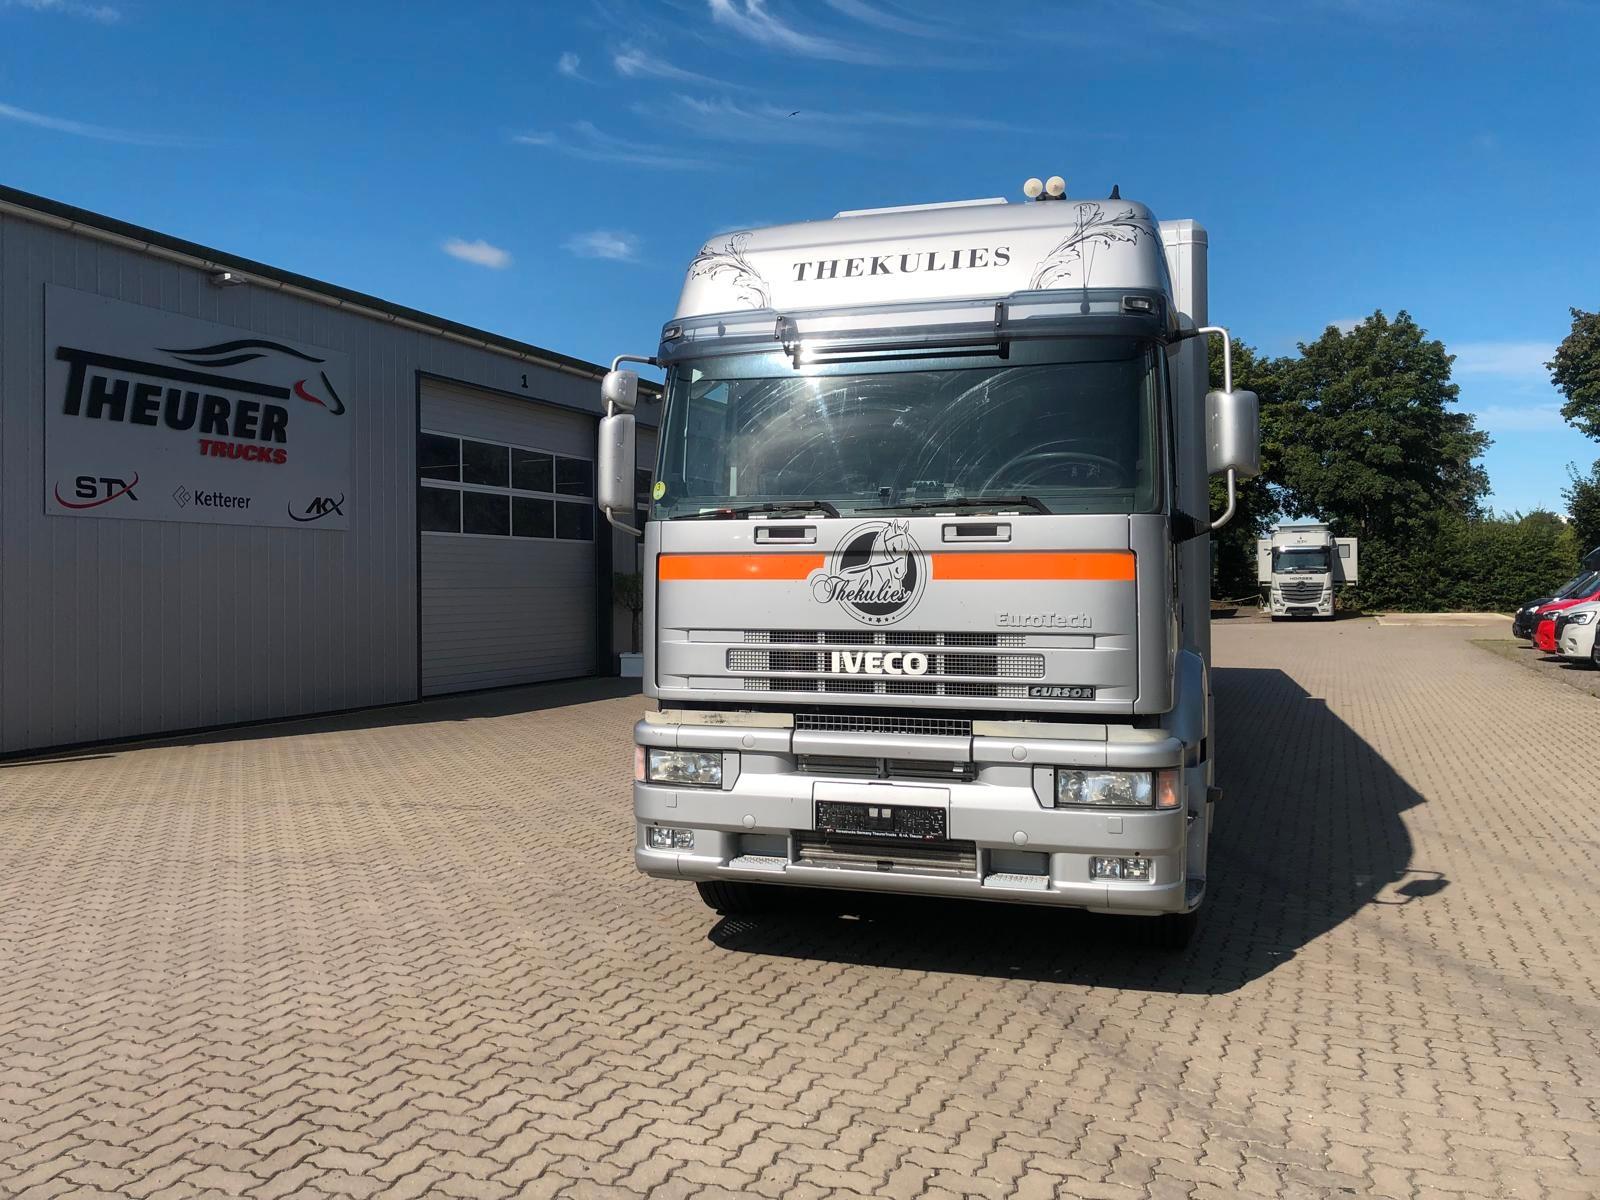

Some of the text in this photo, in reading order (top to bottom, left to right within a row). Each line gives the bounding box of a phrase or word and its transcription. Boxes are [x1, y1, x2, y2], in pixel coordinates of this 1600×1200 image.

[792, 246, 1010, 282] THEKULIES
[521, 374, 528, 389] 1
[55, 346, 290, 443] THEURER
[197, 438, 288, 465] TRUCKS
[75, 472, 138, 501] STX
[194, 490, 251, 509] Ketterer
[811, 575, 909, 603] Thekulies
[996, 612, 1092, 628] EuroTech
[831, 651, 928, 675] IVECO
[1030, 687, 1092, 698] CURSOR
